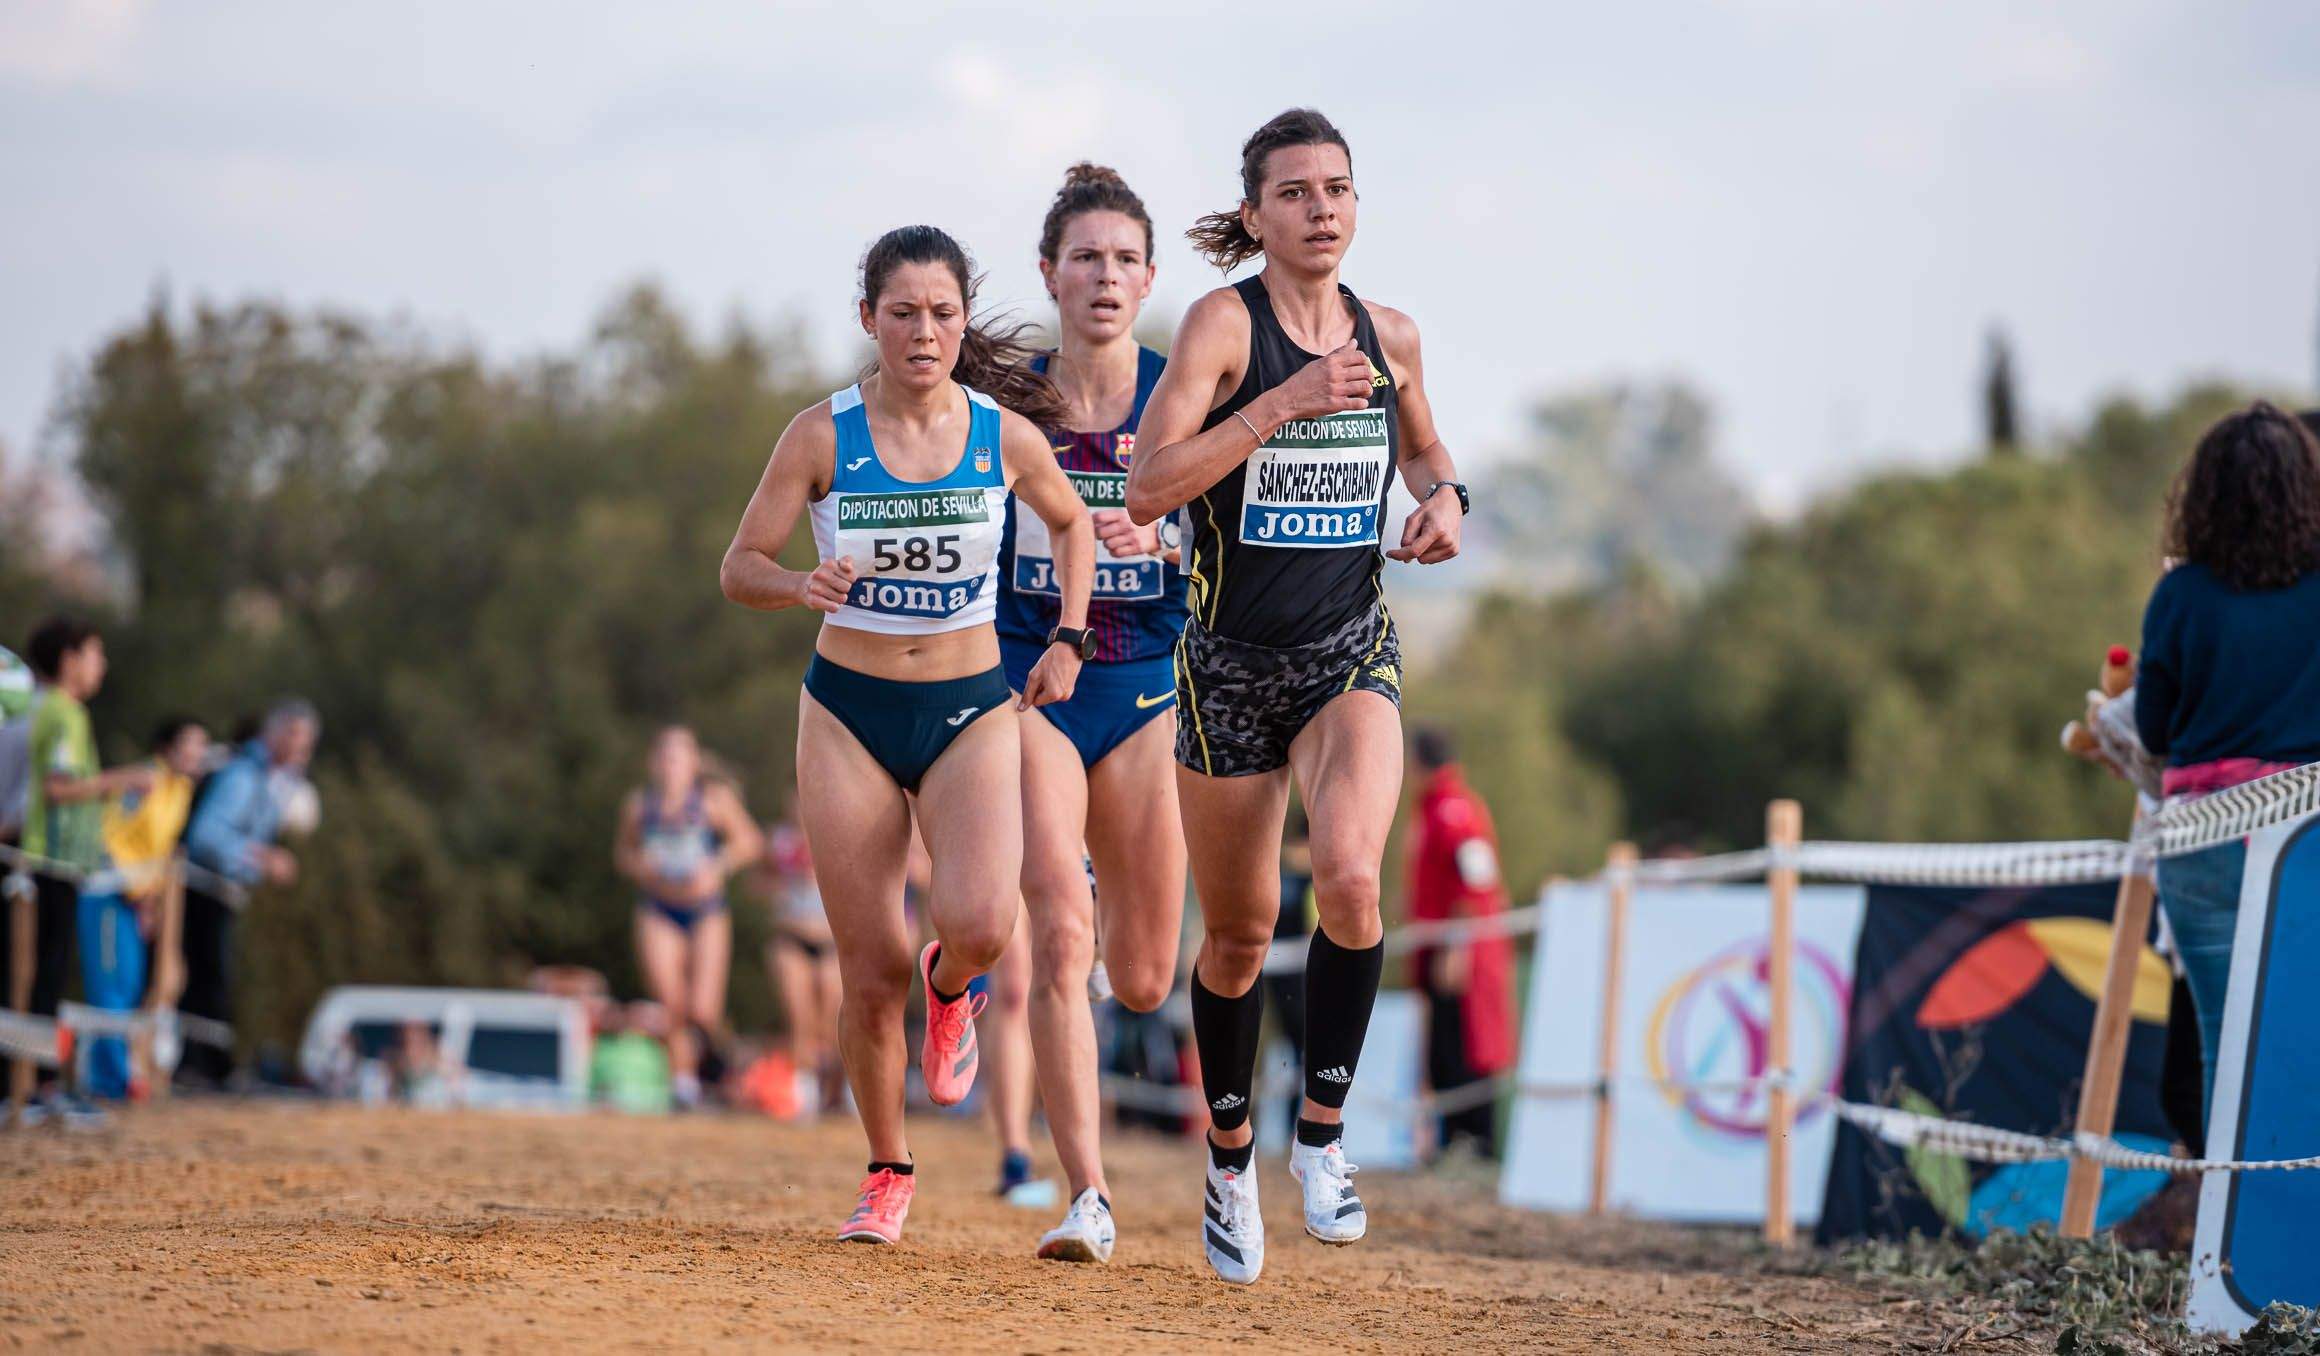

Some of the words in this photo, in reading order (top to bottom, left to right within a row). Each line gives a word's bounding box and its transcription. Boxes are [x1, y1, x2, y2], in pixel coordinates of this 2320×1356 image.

[1275, 421, 1329, 440] UTACION
[1331, 420, 1345, 439] DE
[1345, 419, 1386, 438] SEVILLA
[1257, 453, 1379, 502] SÁNCHEZ-ESCRIBANO
[1097, 480, 1115, 499] DE
[922, 497, 940, 517] DE
[942, 495, 988, 516] SEVILLA
[873, 535, 962, 573] 585
[1031, 563, 1142, 592] Jma
[1316, 1071, 1352, 1083] adidas
